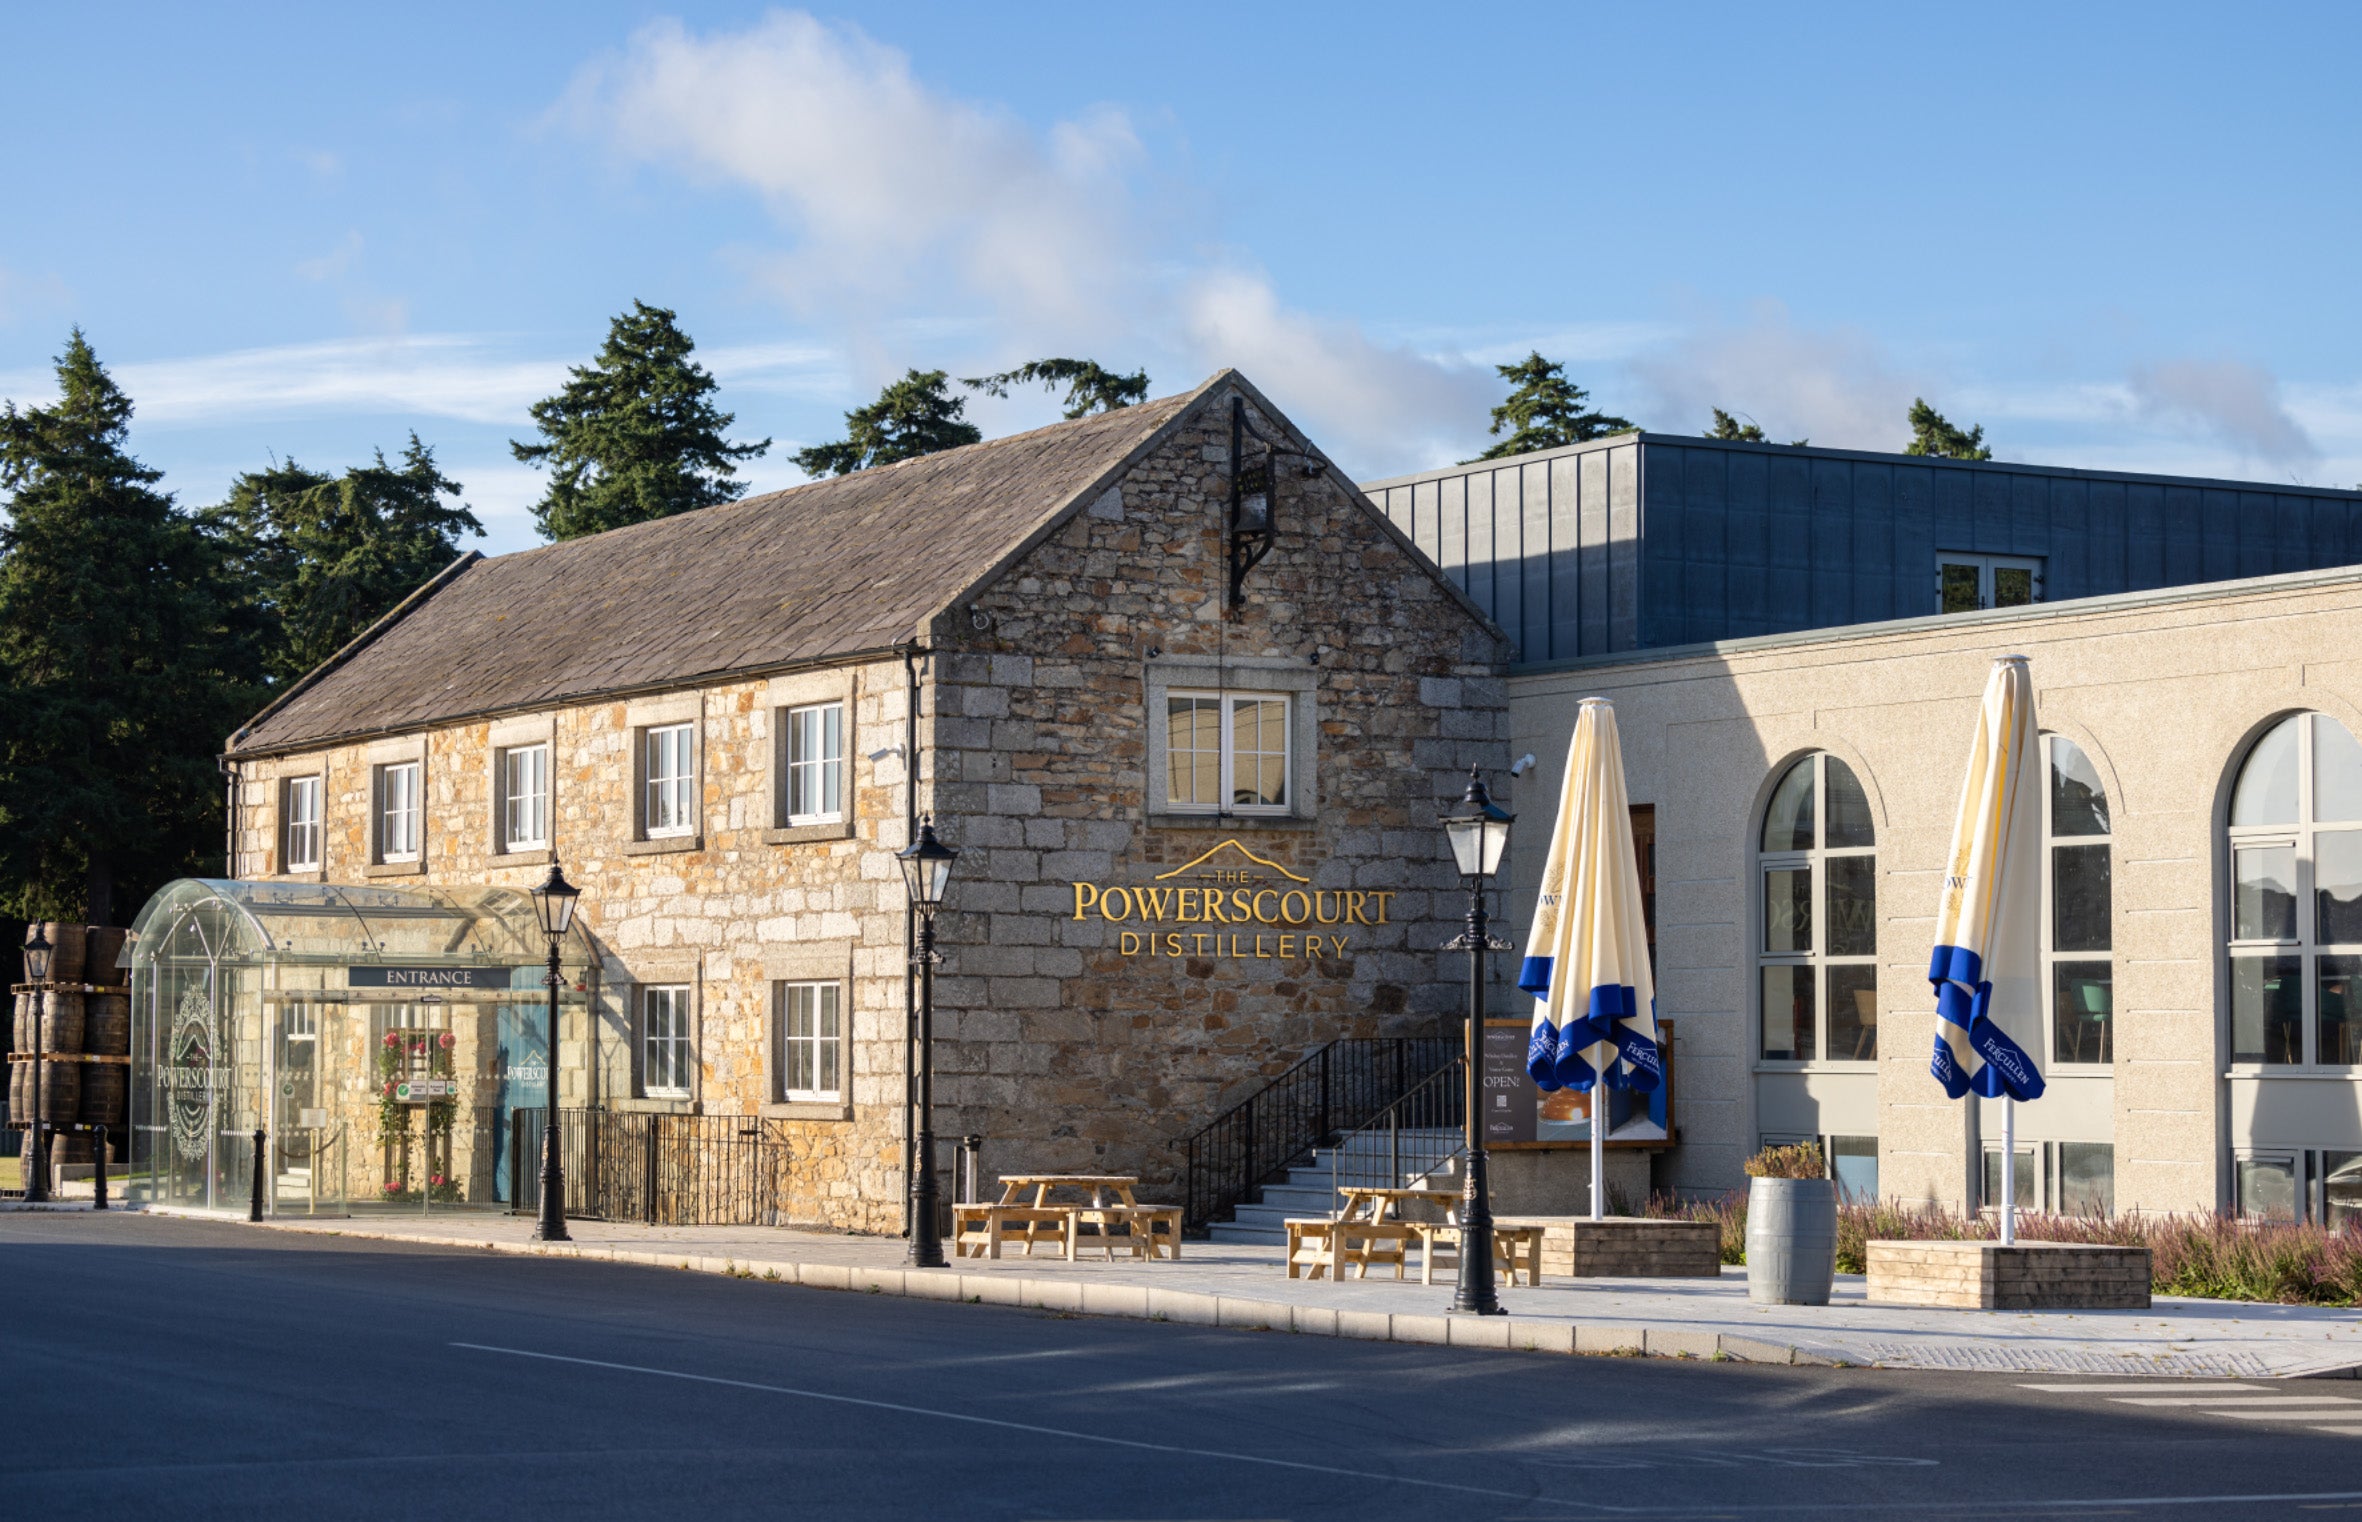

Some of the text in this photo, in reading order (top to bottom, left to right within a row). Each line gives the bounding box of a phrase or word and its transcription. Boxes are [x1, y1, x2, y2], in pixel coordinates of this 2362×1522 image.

[1214, 869, 1249, 884] THE
[1072, 881, 1396, 926] POWERSCOURT
[1120, 931, 1350, 960] DISTILLERY
[386, 969, 472, 985] ENTRANCE
[1982, 1036, 2030, 1085] FERCULLEN
